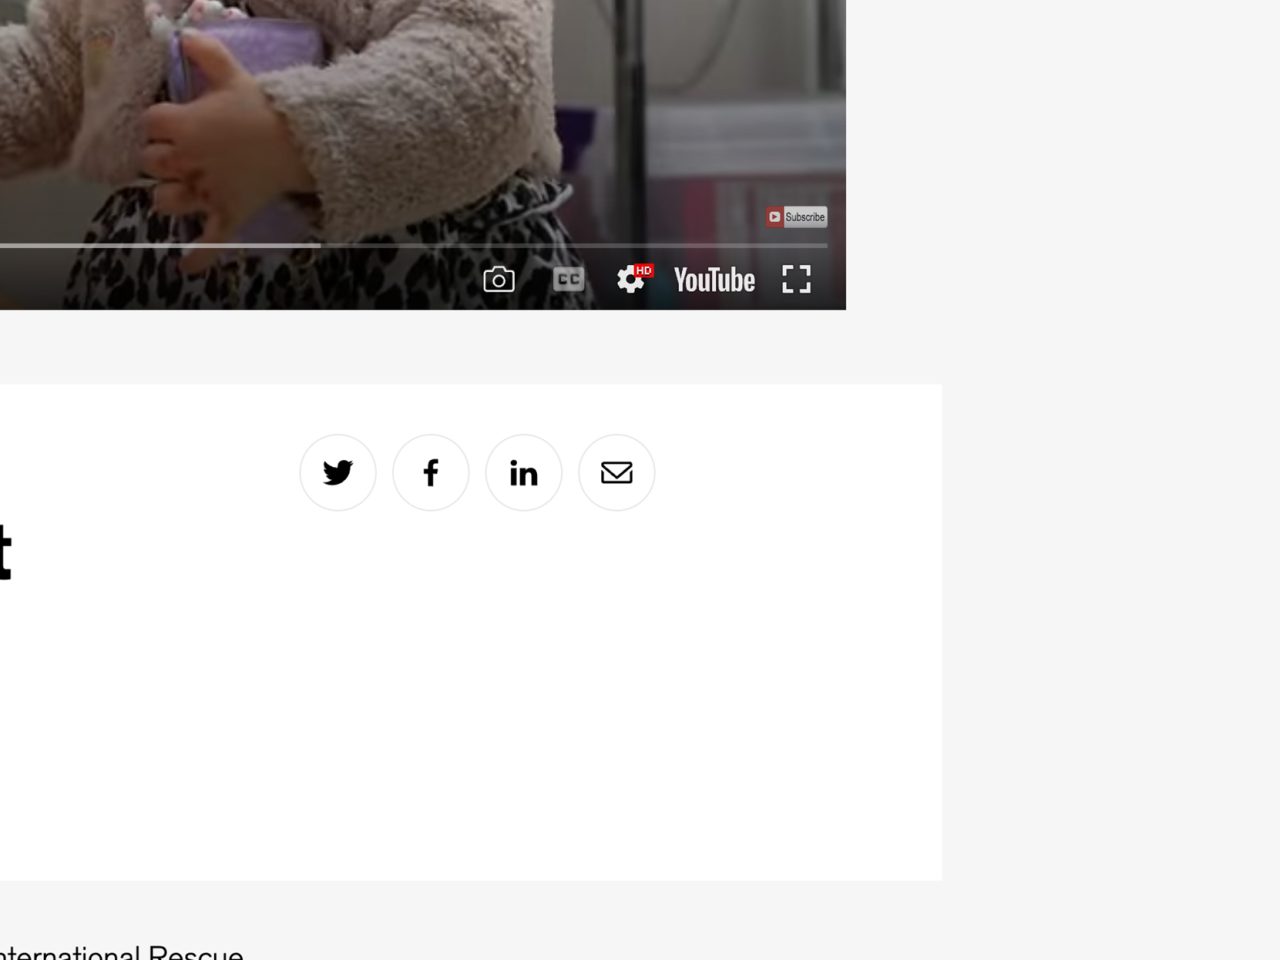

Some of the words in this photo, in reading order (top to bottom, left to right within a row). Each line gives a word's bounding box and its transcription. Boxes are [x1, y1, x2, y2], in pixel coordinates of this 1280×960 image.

[786, 211, 825, 222] Subscribe
[636, 266, 652, 275] HD
[558, 273, 580, 286] CC
[674, 266, 756, 292] YouTube
[510, 459, 538, 486] in
